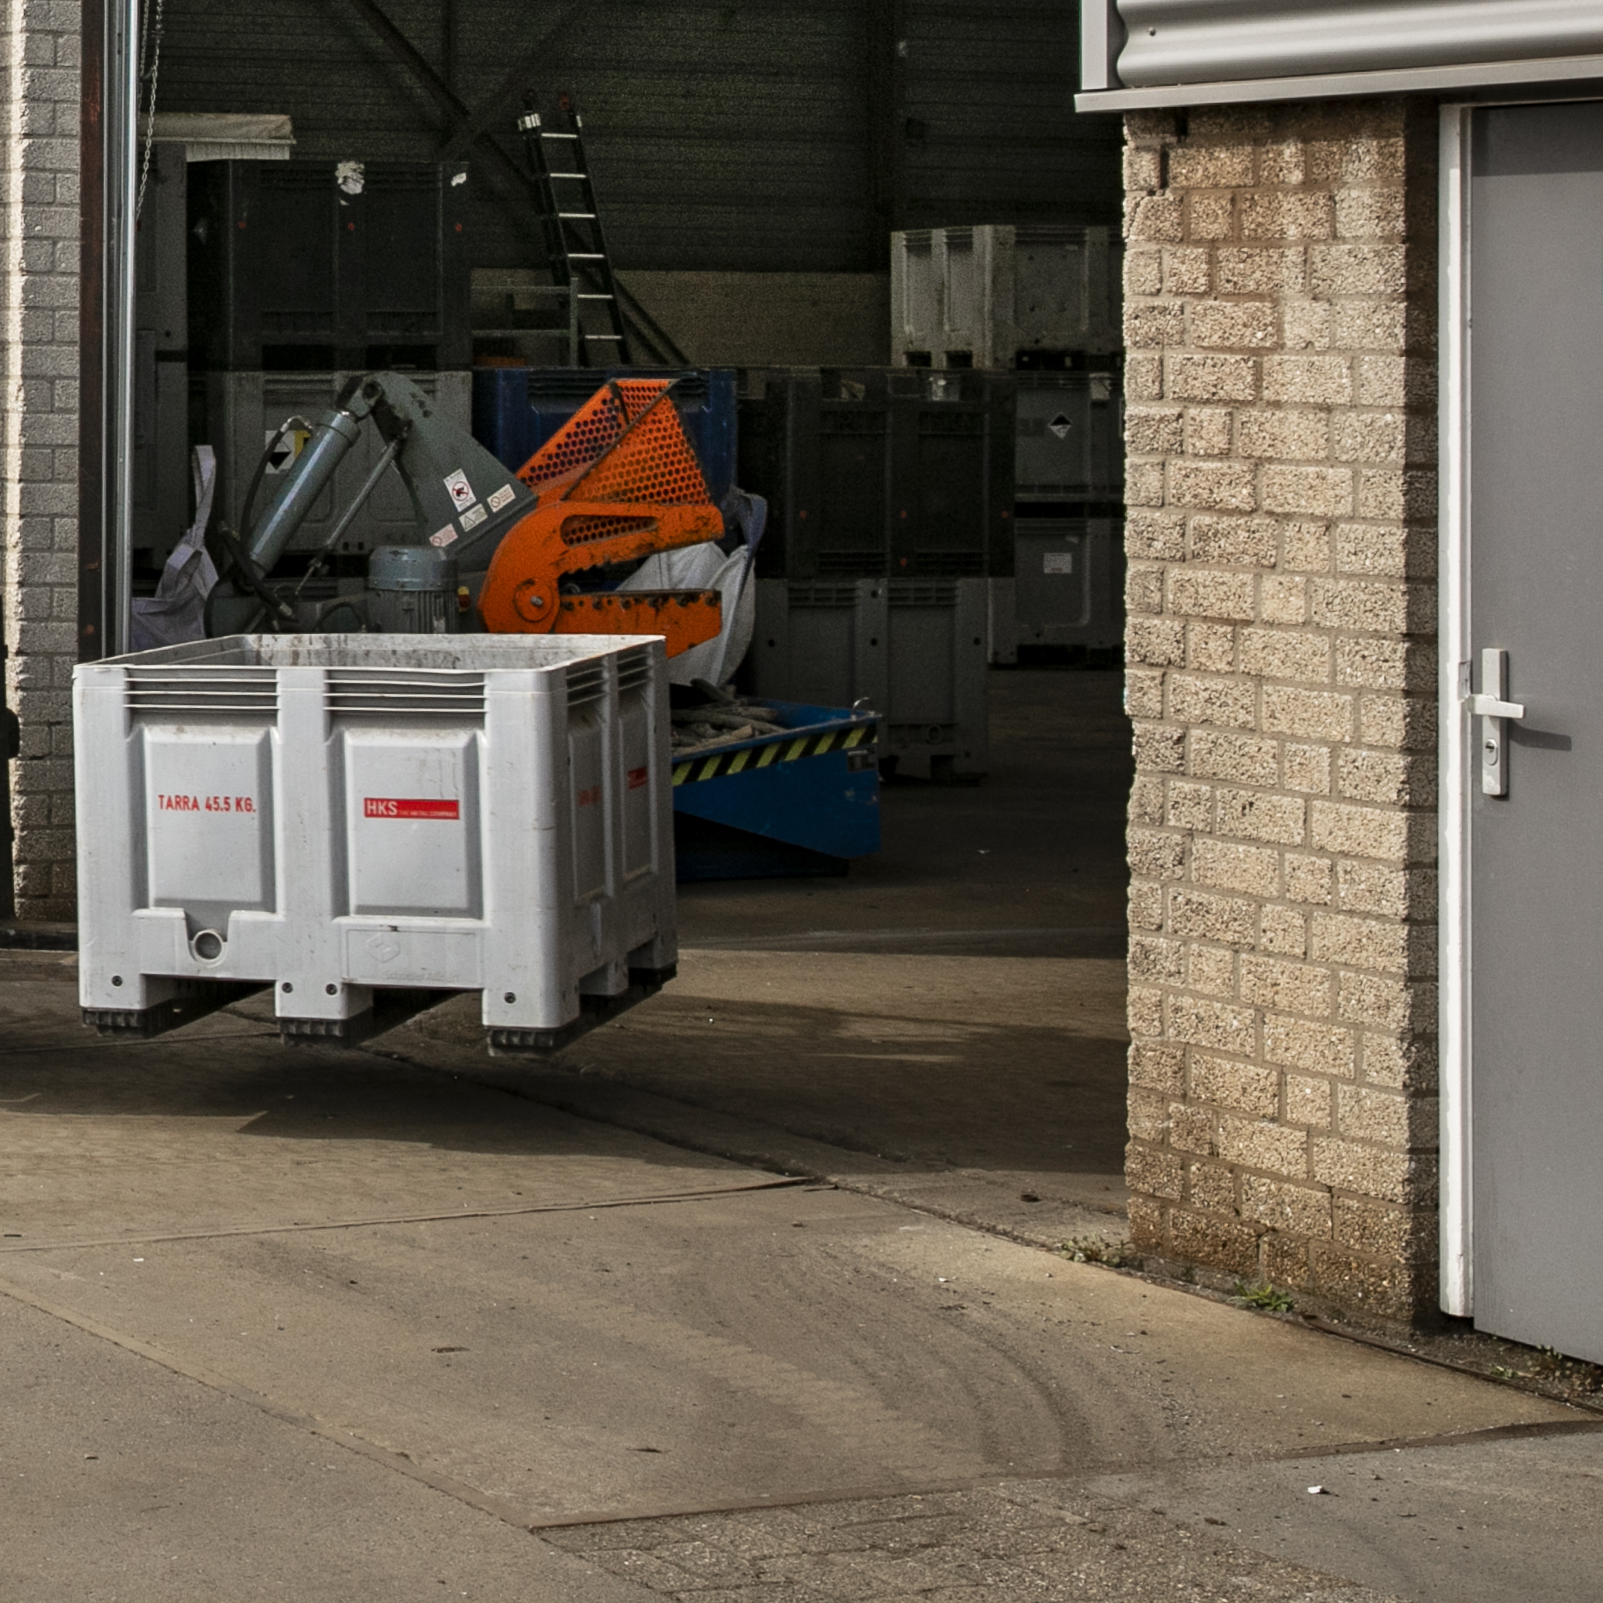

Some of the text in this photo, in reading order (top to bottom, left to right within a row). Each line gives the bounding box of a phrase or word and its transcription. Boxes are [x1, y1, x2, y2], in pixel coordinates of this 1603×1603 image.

[157, 794, 256, 813] TARRA 45.5 KG.
[366, 799, 398, 816] HKS
